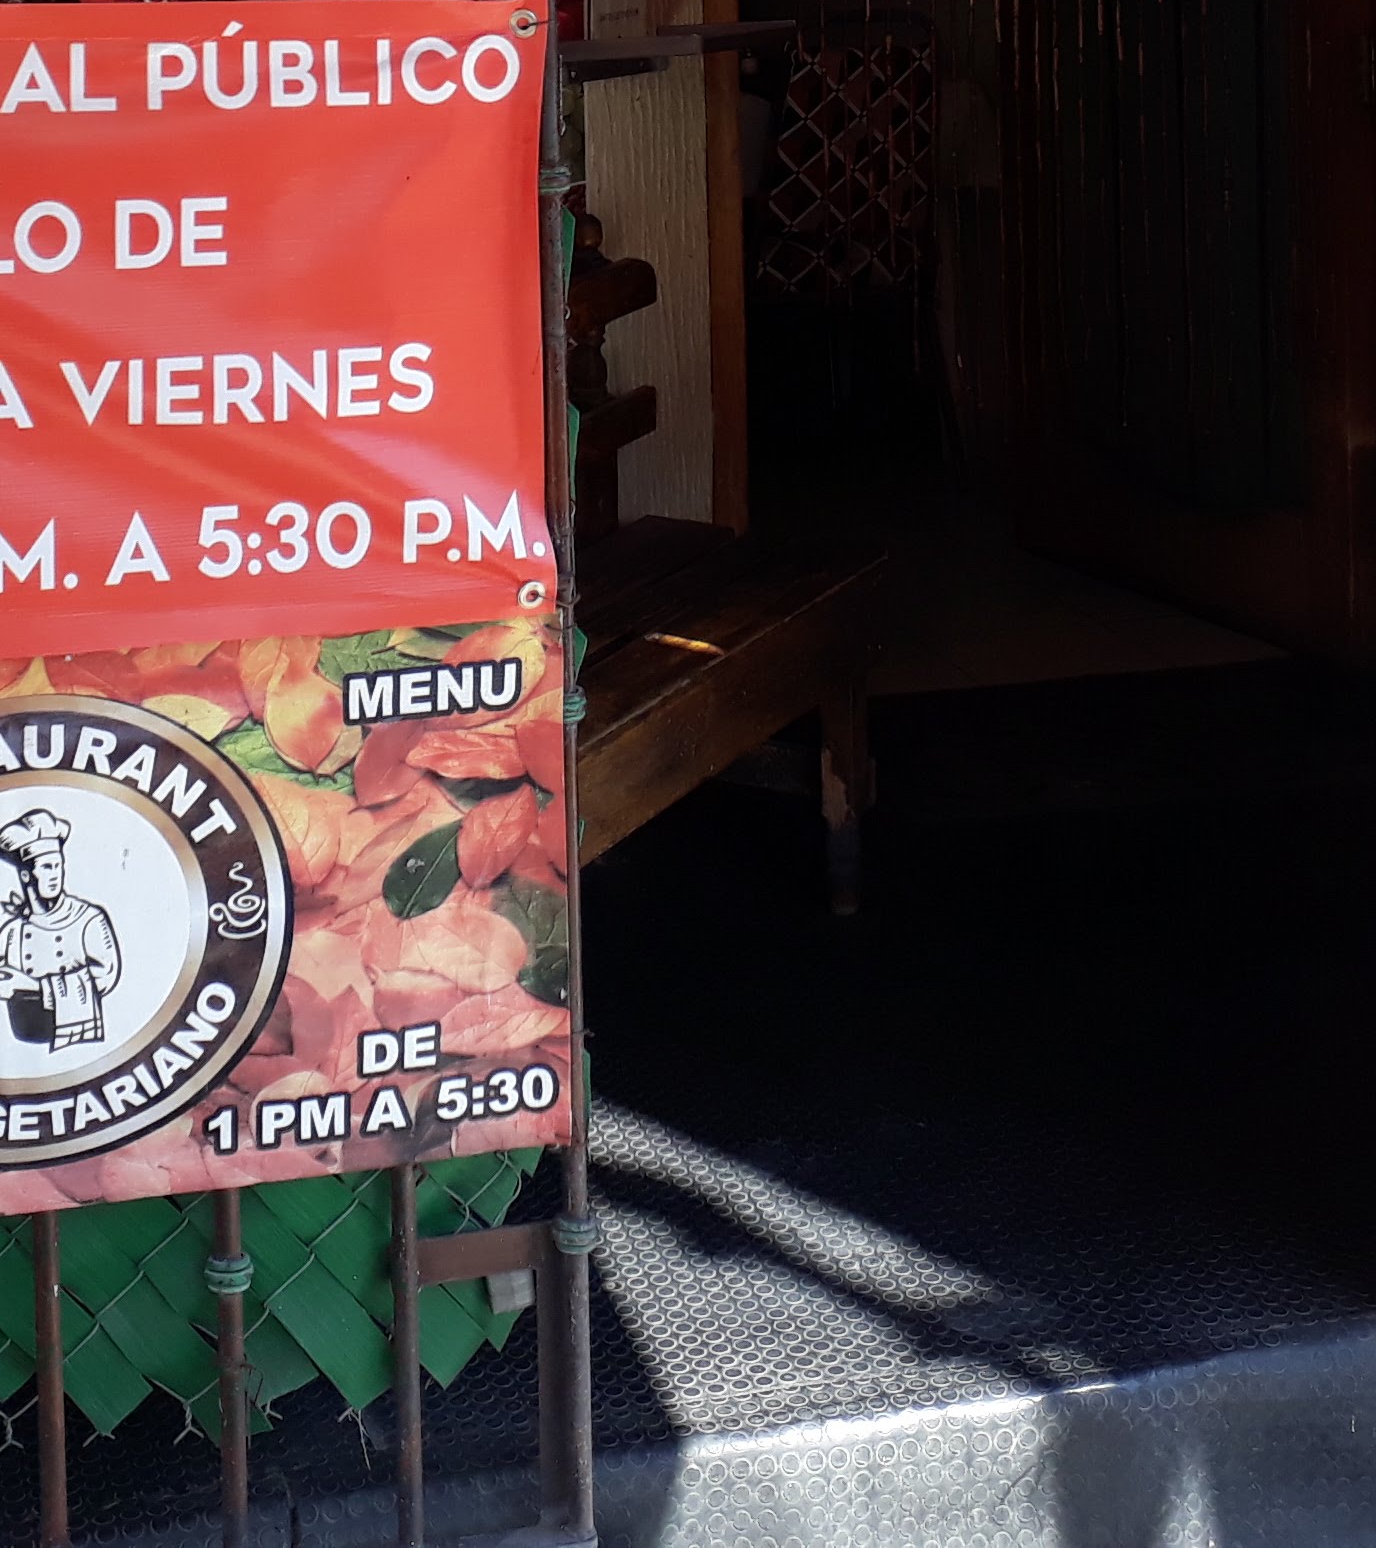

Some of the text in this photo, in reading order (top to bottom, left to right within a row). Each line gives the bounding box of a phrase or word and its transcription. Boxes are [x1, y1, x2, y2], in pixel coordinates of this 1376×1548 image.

[0, 42, 118, 114] AL
[147, 20, 522, 112] PÚBLICO
[115, 196, 228, 271] DE
[59, 342, 435, 427] VIERNES
[104, 510, 171, 586] A
[196, 500, 372, 580] 5:30
[403, 489, 547, 565] P.M.
[348, 662, 517, 721] MENU
[362, 1025, 437, 1075] DE
[207, 1066, 555, 1151] 1 PM A 5:30
